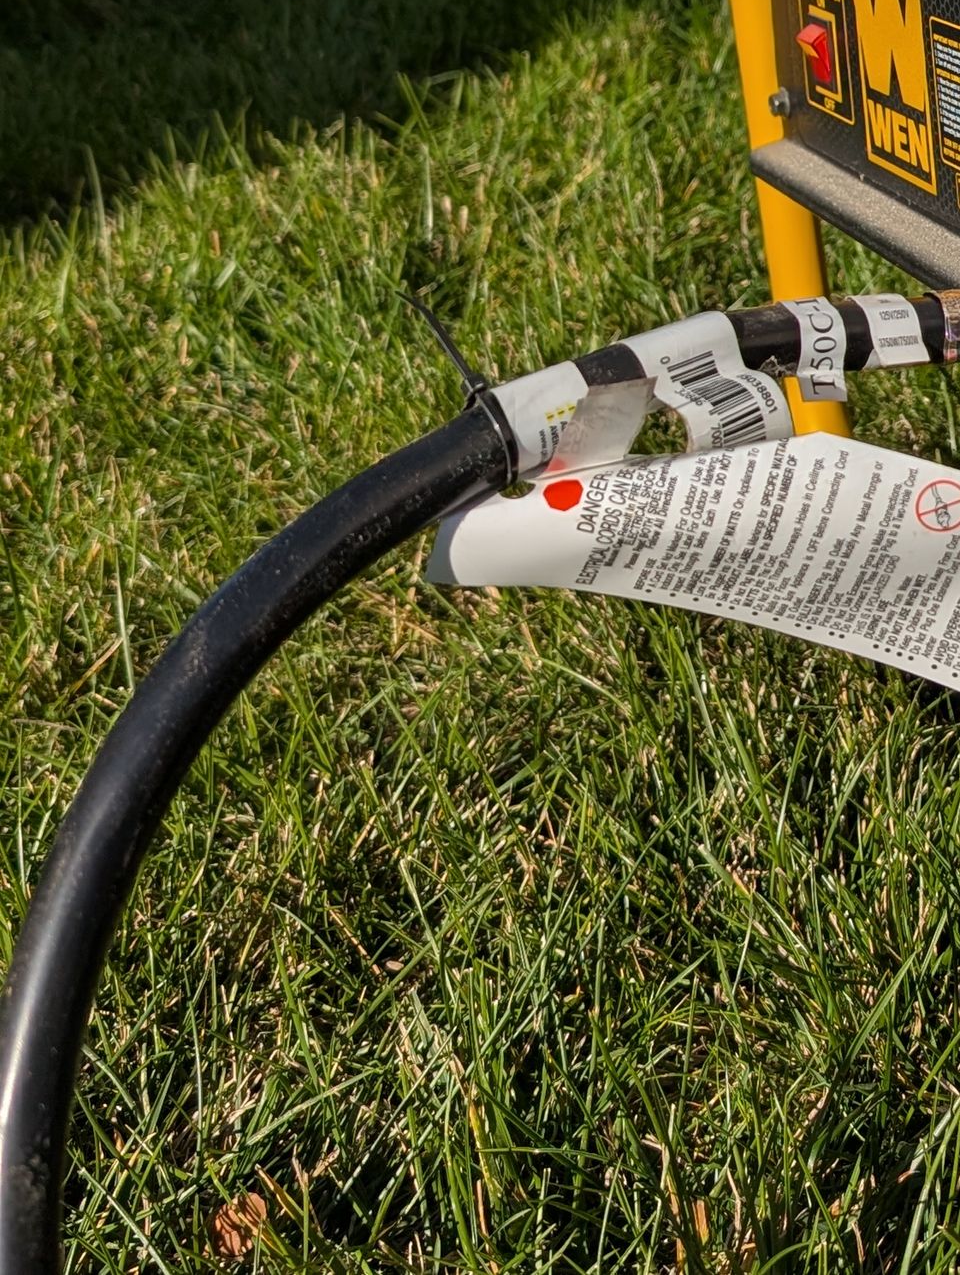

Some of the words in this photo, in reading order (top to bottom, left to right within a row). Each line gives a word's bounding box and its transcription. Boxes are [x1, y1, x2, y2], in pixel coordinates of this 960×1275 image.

[867, 98, 930, 174] WEN
[616, 466, 636, 480] BE
[640, 468, 658, 499] SHOCK
[608, 480, 630, 506] CAN
[596, 507, 623, 544] CORDS
[913, 574, 928, 588] WET.
[904, 588, 920, 606] WHEN
[863, 614, 883, 640] DURING
[876, 599, 890, 612] USE
[898, 607, 911, 621] USE
[890, 620, 904, 636] NOT
[886, 635, 898, 647] DO
